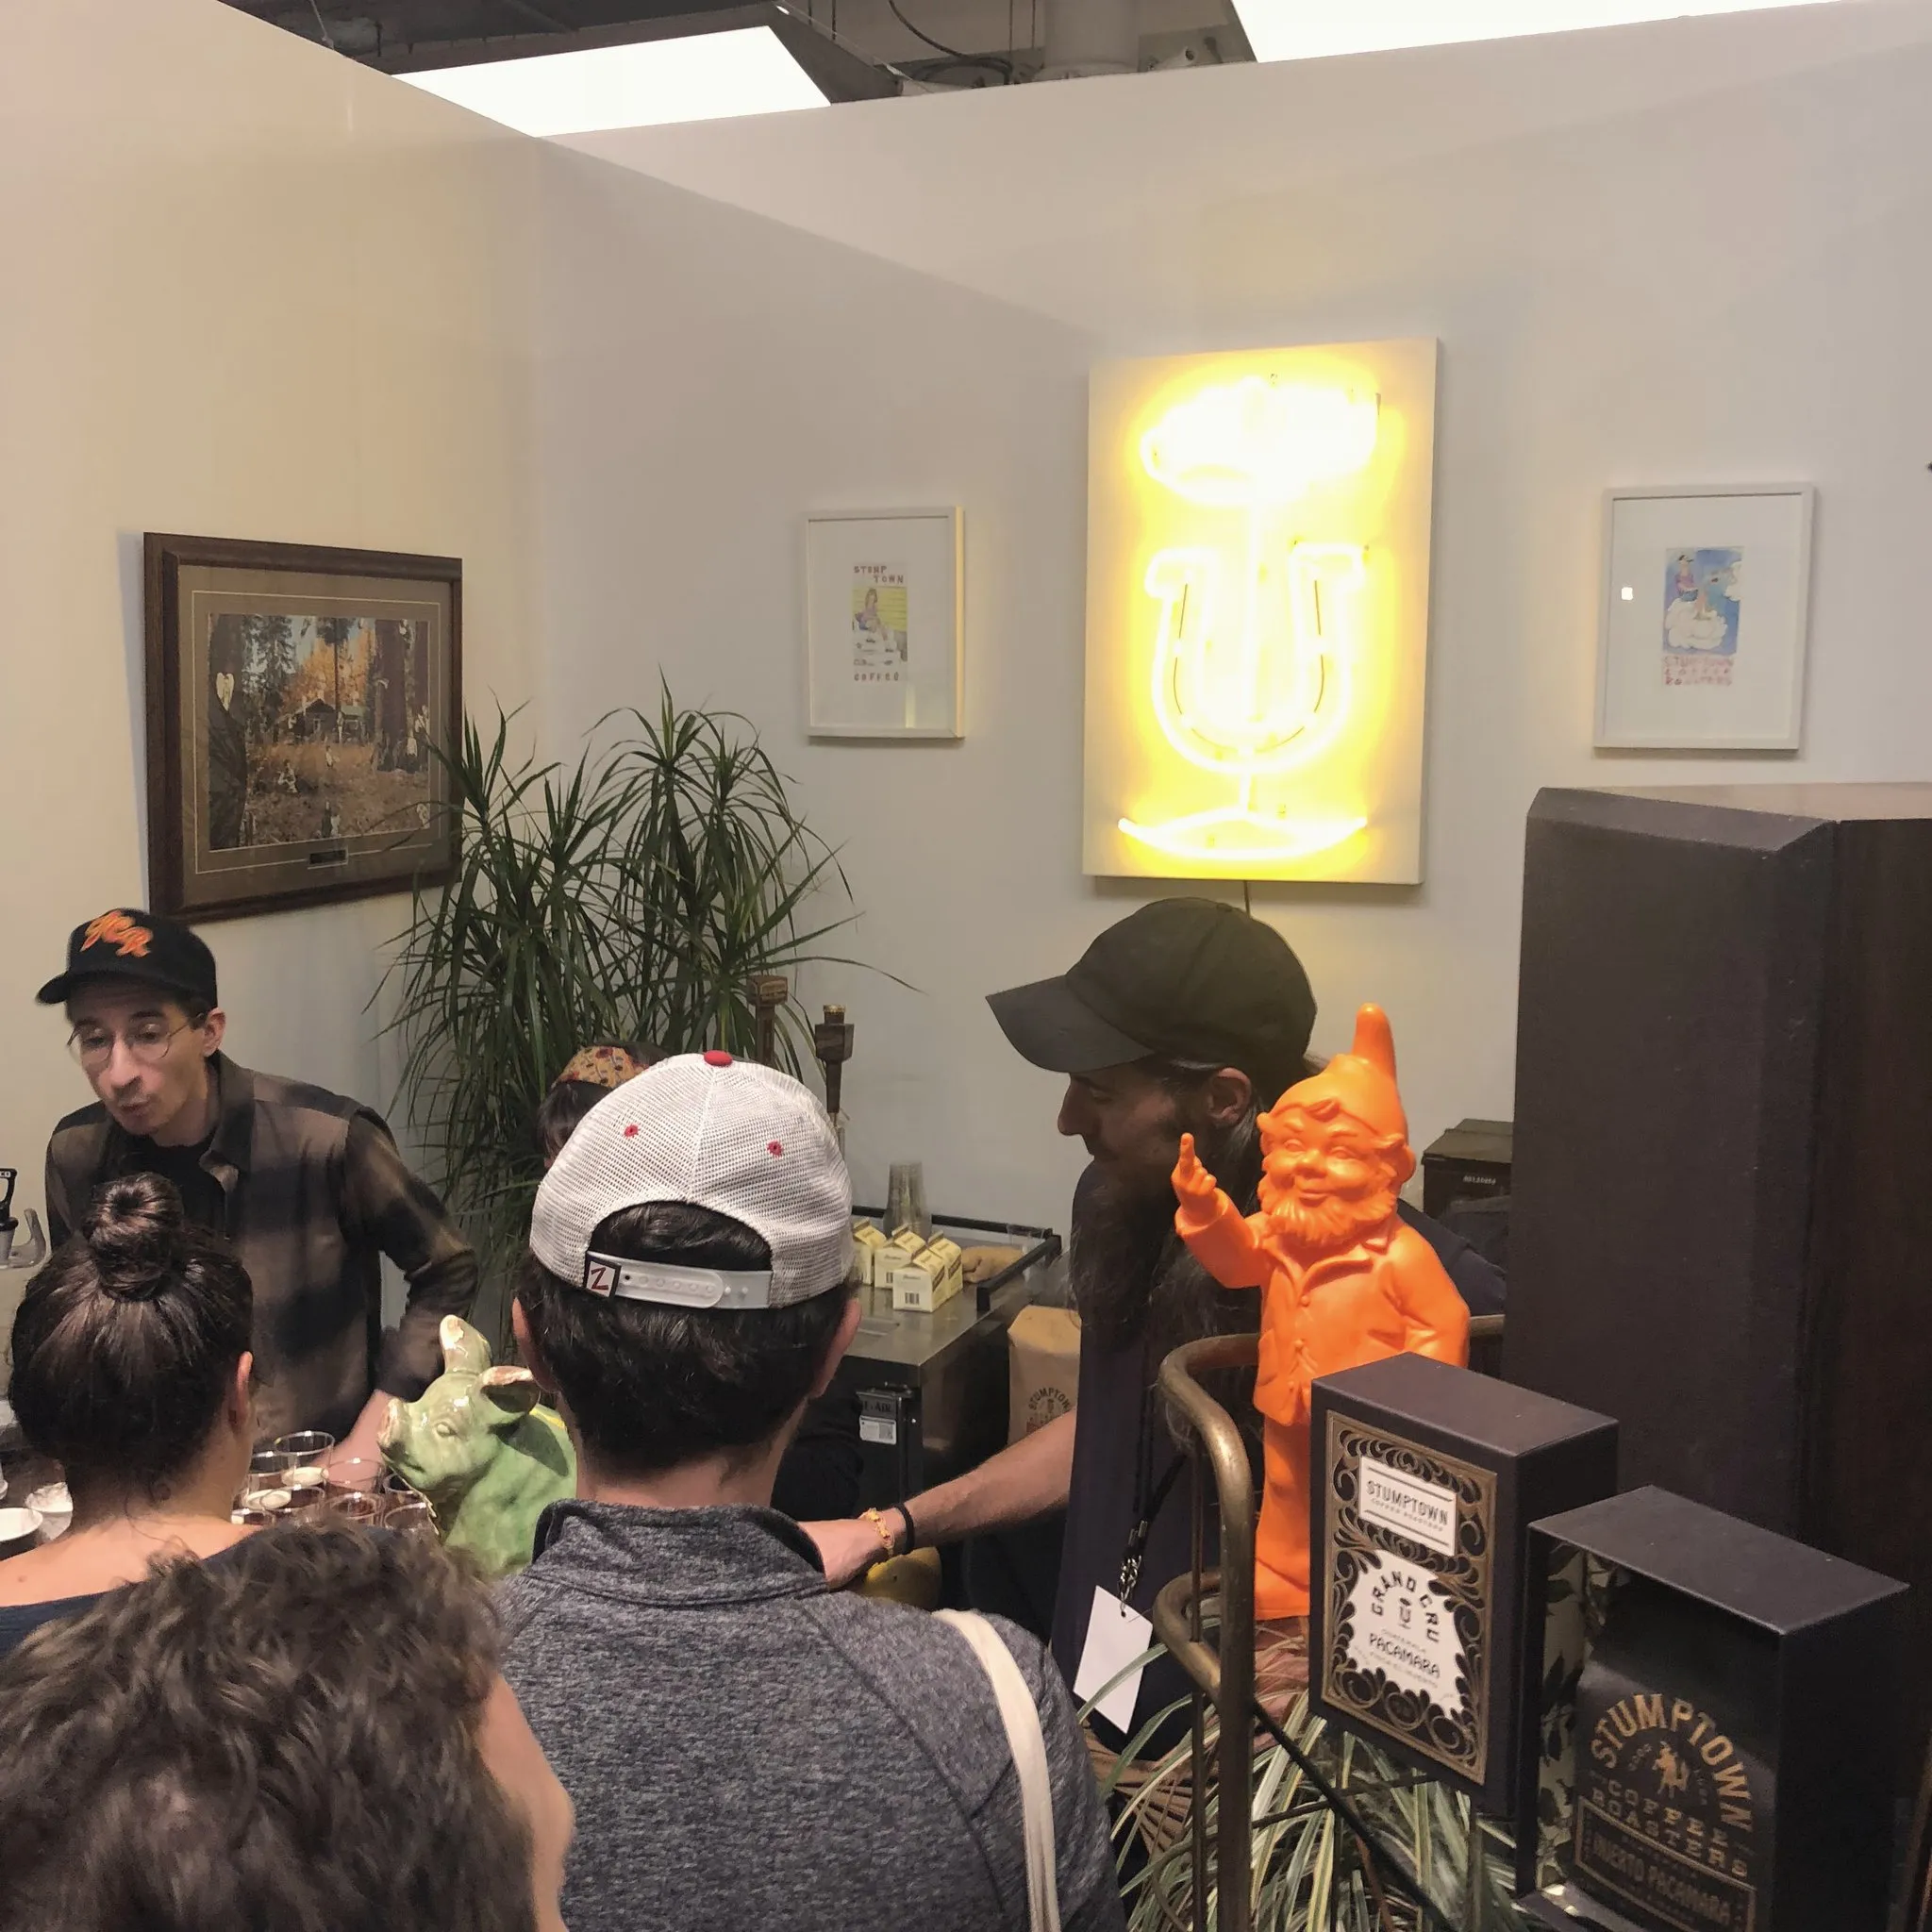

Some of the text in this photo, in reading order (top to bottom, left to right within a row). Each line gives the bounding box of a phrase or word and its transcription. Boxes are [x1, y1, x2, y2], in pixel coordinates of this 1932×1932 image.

[874, 575, 904, 584] TOWN
[590, 1267, 610, 1291] Z
[1028, 1387, 1071, 1413] STUMPTOW
[1366, 1480, 1448, 1525] STUMPTOWN
[1372, 1571, 1417, 1617] GRAND
[1420, 1594, 1441, 1643] CRU
[1370, 1633, 1441, 1679] PACAMARA
[1591, 1693, 1754, 1833] STUMPTOWN
